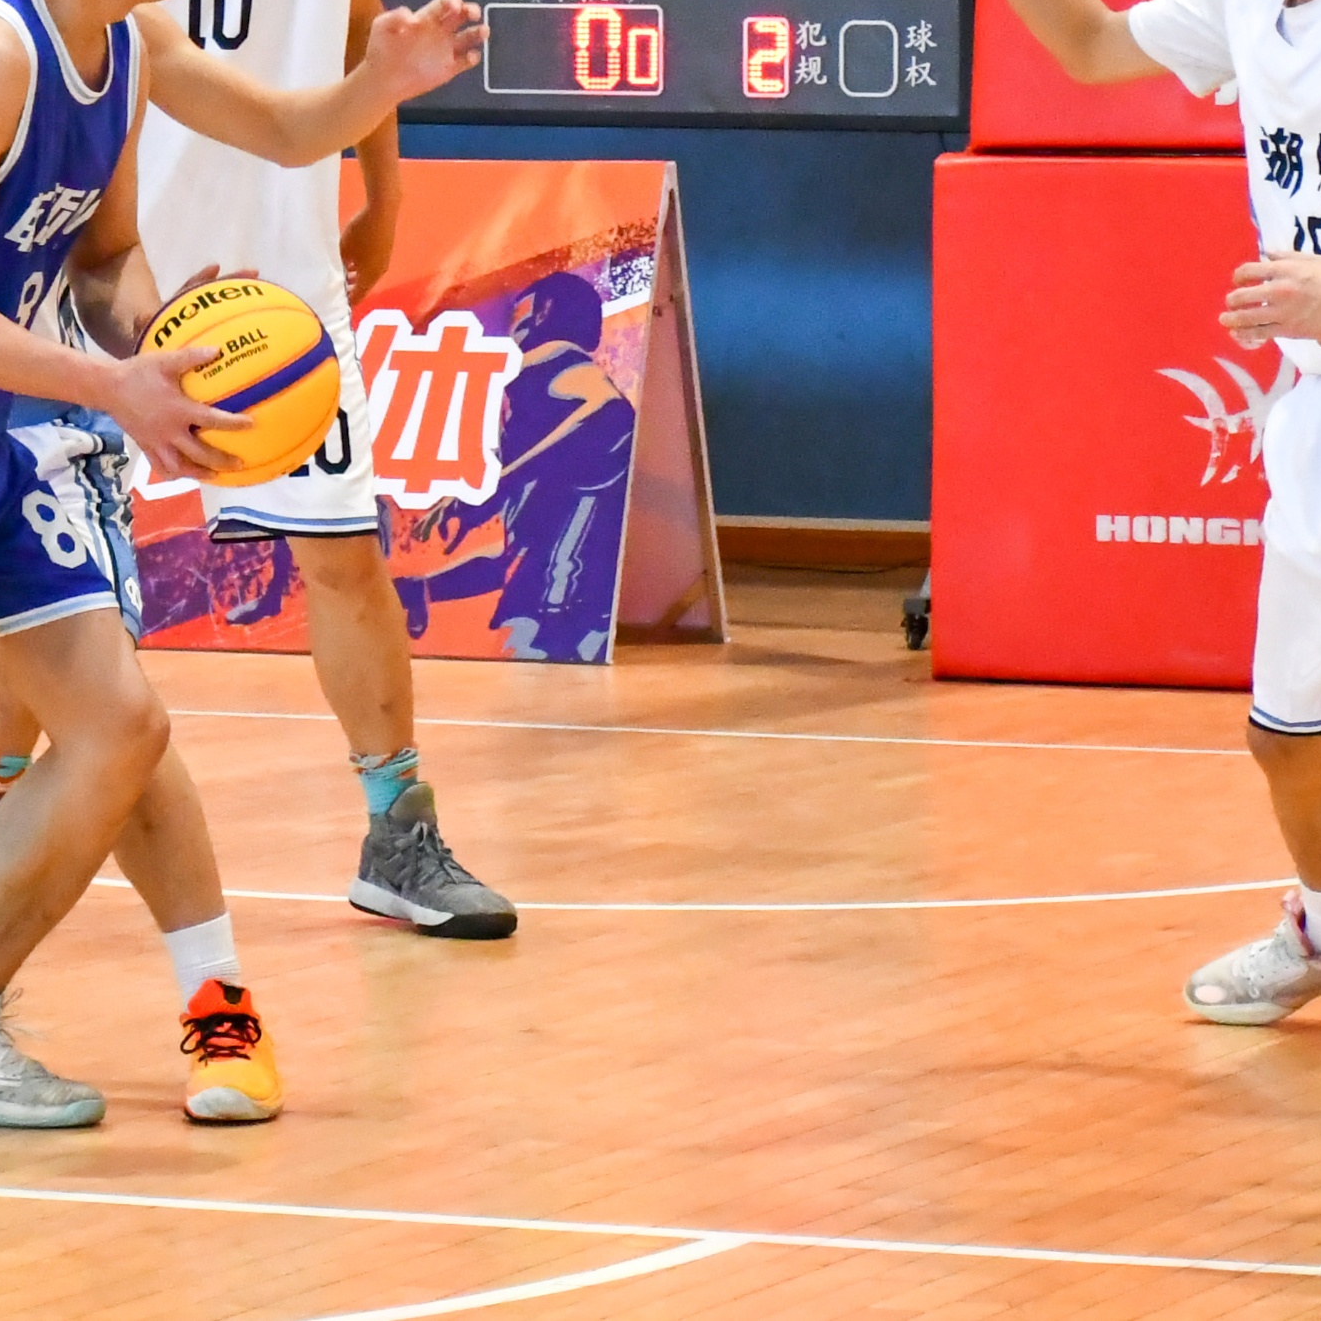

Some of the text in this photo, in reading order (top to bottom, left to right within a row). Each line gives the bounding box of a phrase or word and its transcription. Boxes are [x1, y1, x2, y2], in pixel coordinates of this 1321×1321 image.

[748, 19, 788, 93] 2
[794, 20, 828, 86] 犯规
[904, 19, 938, 87] 球权
[153, 283, 265, 349] molten
[225, 328, 269, 355] BALL
[224, 342, 269, 369] APPROVED
[21, 488, 88, 570] 8
